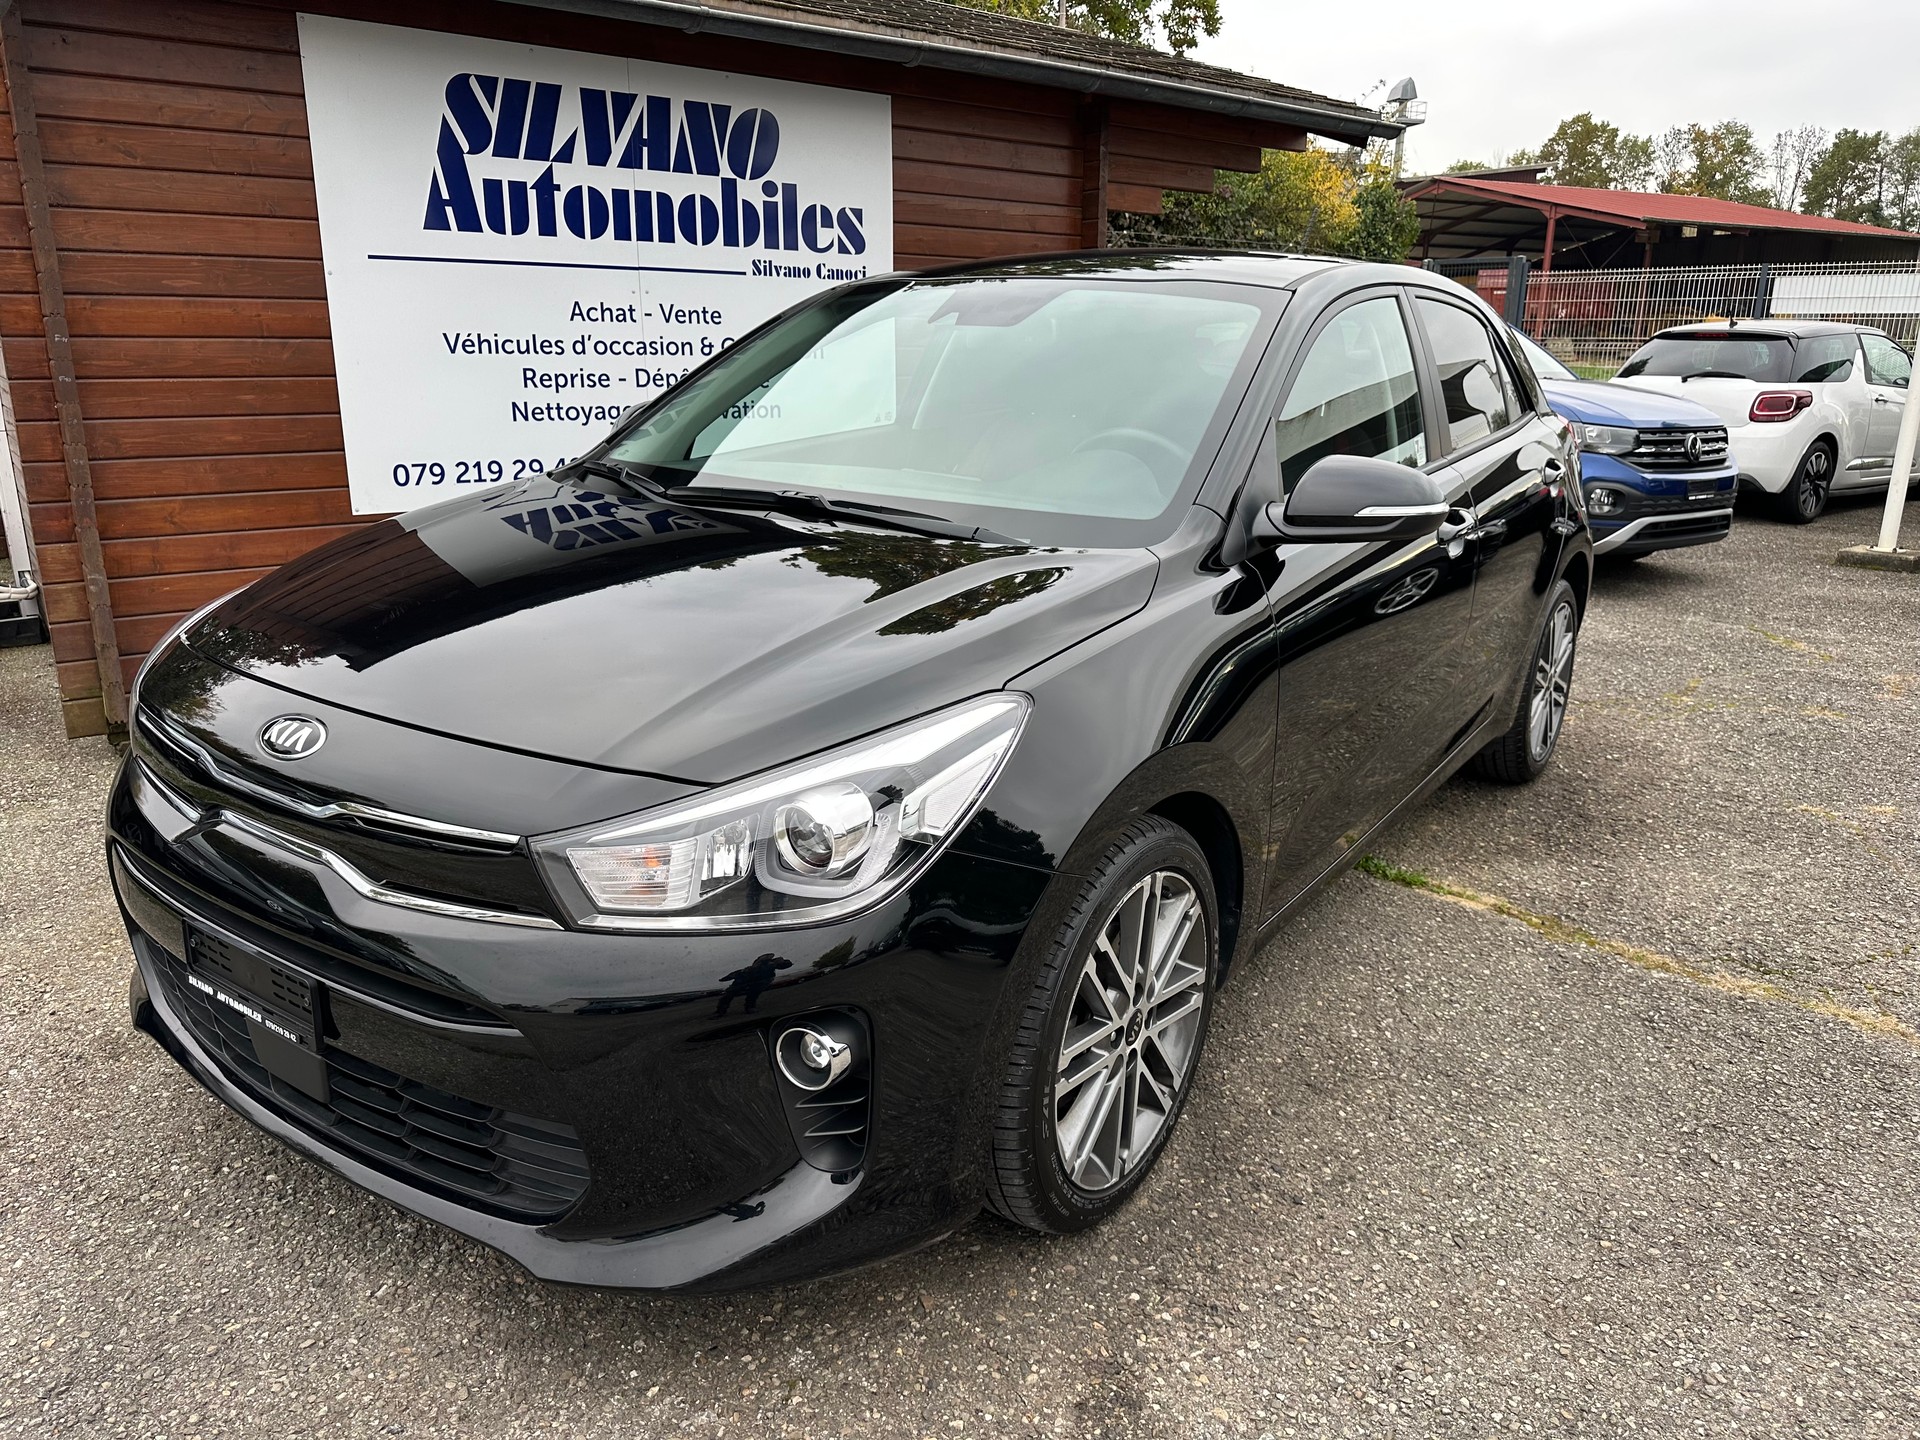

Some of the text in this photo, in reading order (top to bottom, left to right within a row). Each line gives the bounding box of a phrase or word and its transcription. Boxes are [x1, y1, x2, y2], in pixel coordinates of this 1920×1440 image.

[437, 73, 780, 181] SILVANO
[423, 151, 867, 256] Automobiles
[752, 259, 867, 281] Silvano Canoci
[569, 301, 637, 323] Achat
[659, 303, 722, 325] Vente
[442, 332, 565, 356] Véhicules
[572, 334, 694, 356] d'occasion
[700, 337, 714, 356] &
[522, 368, 610, 393] Reprise
[392, 462, 445, 487] 079
[454, 460, 503, 484] 219
[512, 458, 544, 481] 29
[263, 719, 313, 752] KIA
[188, 975, 214, 996] SILVANO
[216, 990, 262, 1023] AUTOMOBILES
